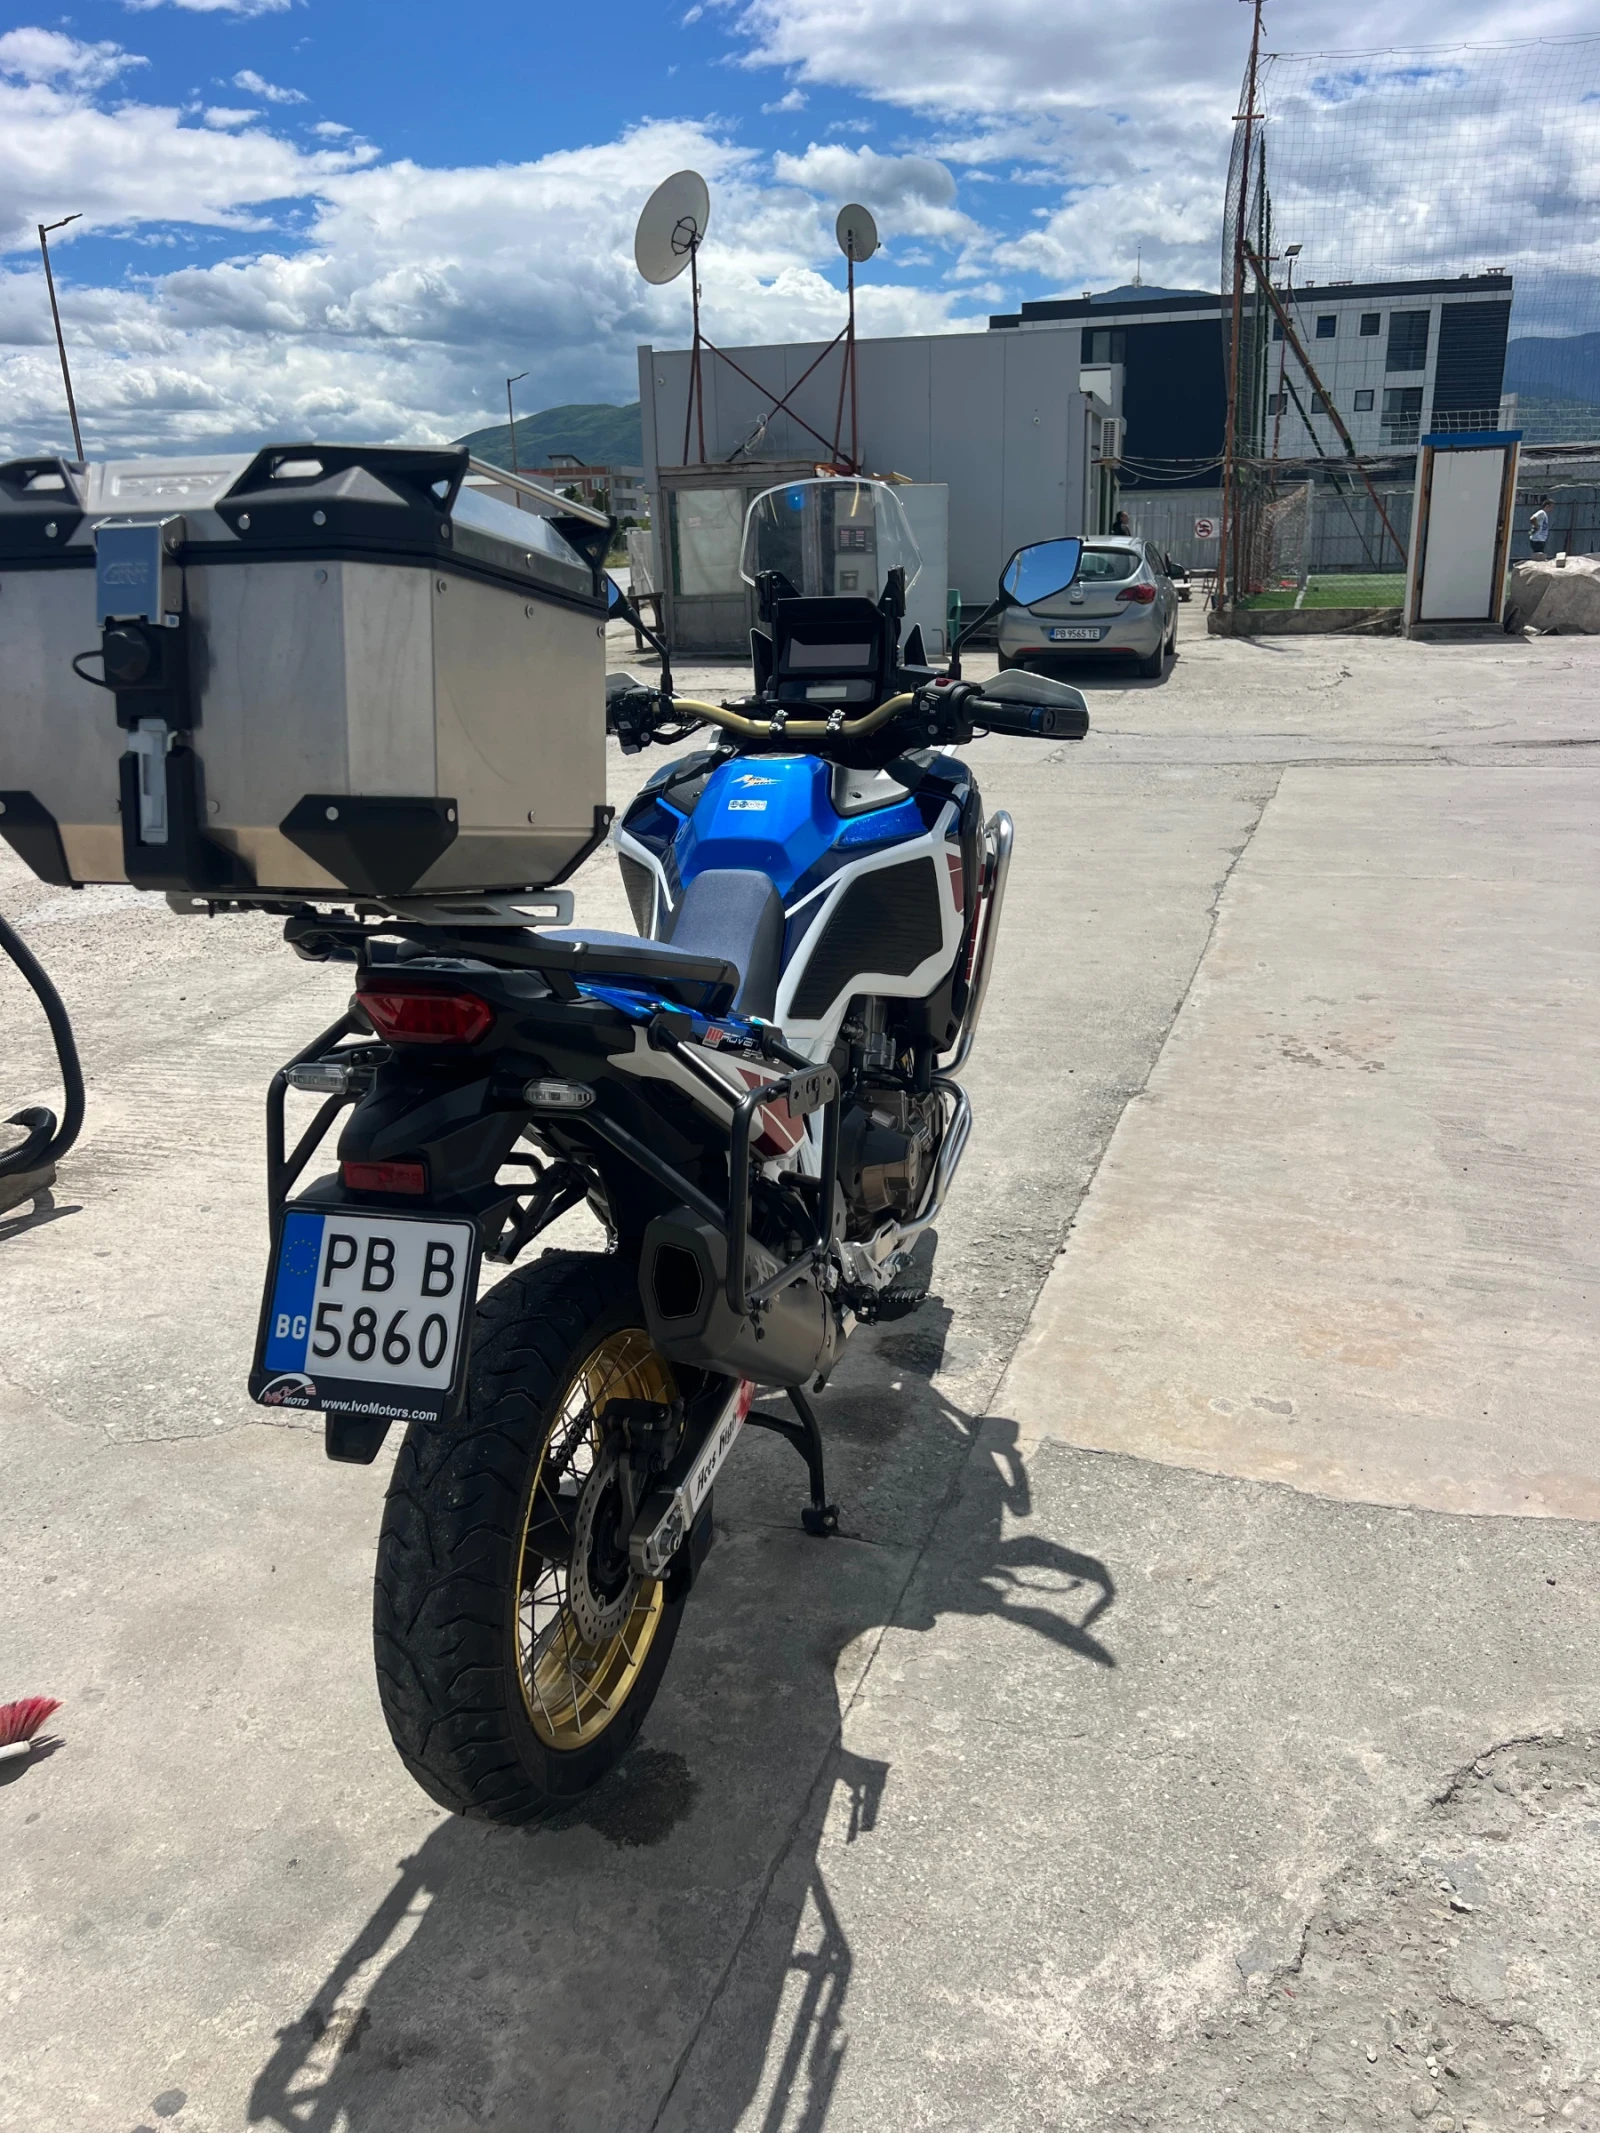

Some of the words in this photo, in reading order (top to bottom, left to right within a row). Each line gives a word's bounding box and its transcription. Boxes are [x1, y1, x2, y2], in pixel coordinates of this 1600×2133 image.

[1088, 630, 1098, 638] TE
[322, 1233, 396, 1292] PB
[420, 1241, 455, 1298] B
[275, 1313, 307, 1340] BG
[312, 1302, 448, 1369] 5860
[282, 1396, 310, 1406] MOTO
[321, 1399, 437, 1421] www.IvoMotors.com
